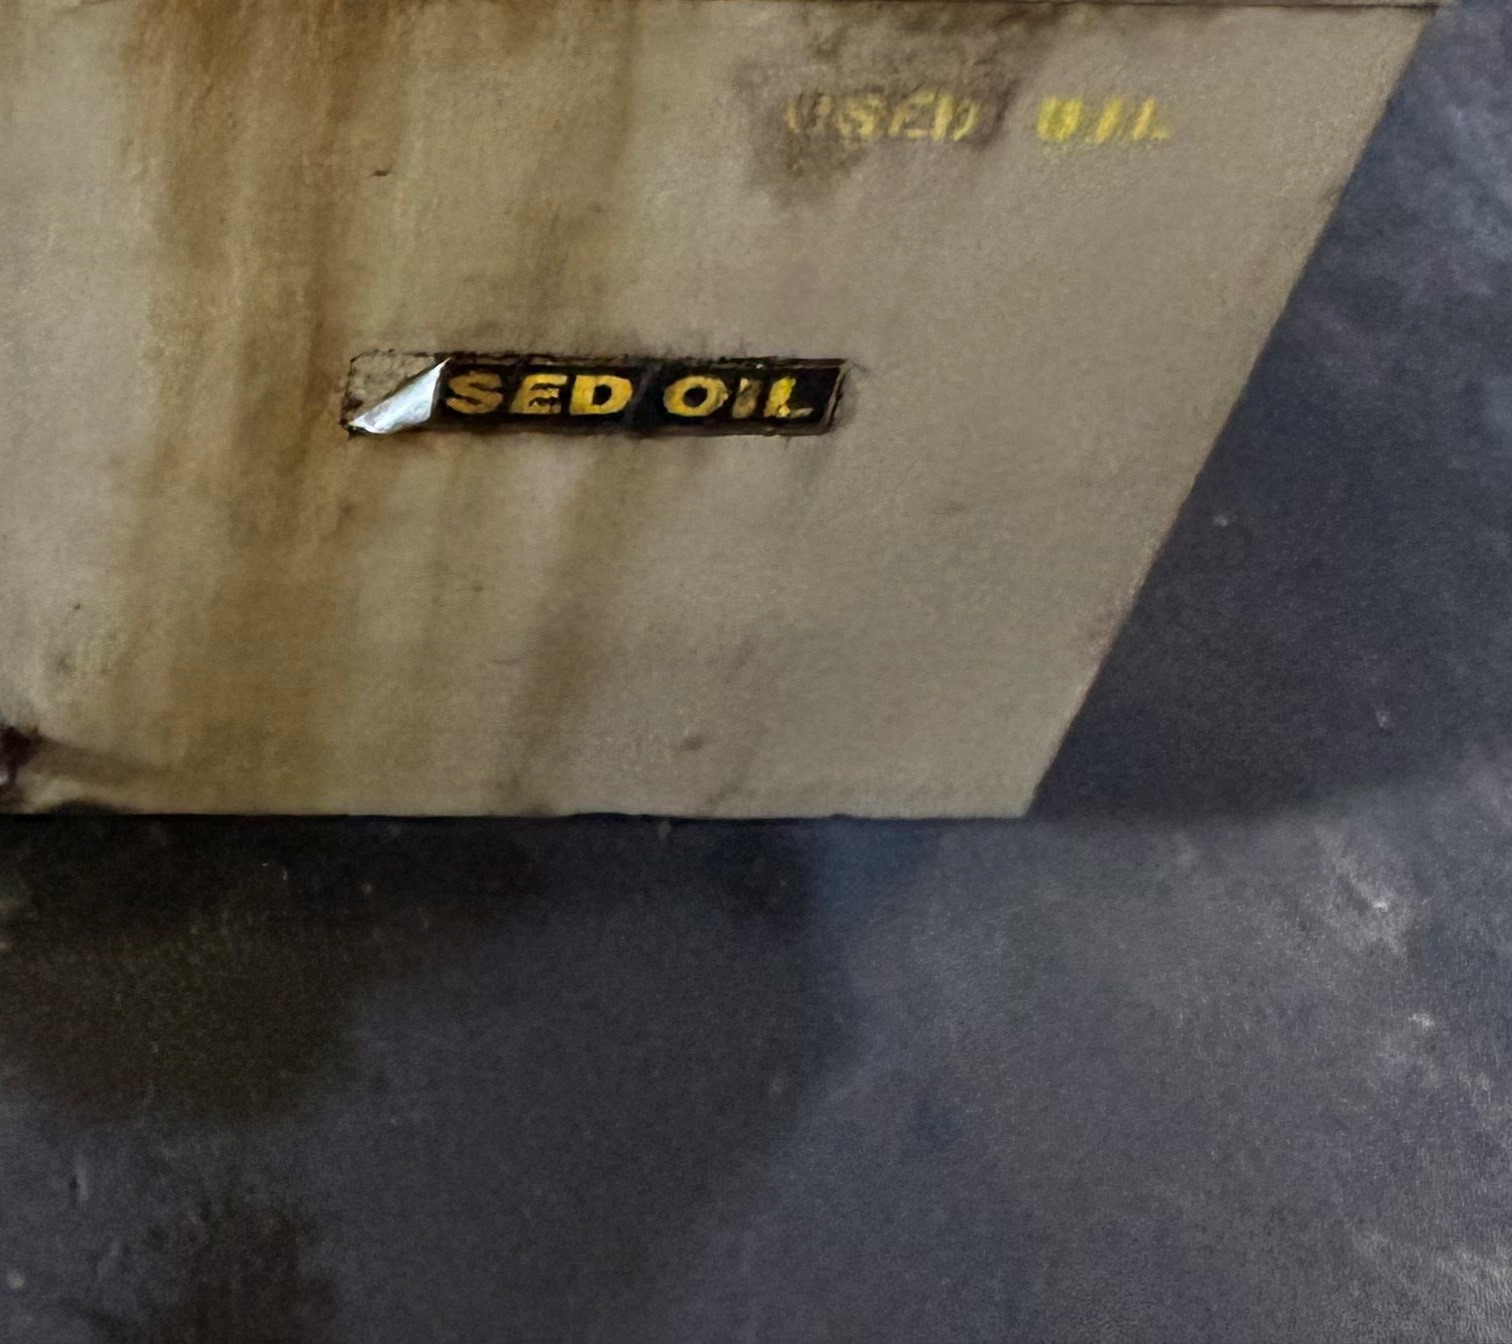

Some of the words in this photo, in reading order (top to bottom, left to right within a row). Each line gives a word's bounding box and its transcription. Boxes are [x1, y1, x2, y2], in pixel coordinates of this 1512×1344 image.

[787, 91, 978, 141] USED
[1036, 95, 1171, 144] OIL
[445, 370, 634, 416] SED
[663, 374, 814, 419] OIL
